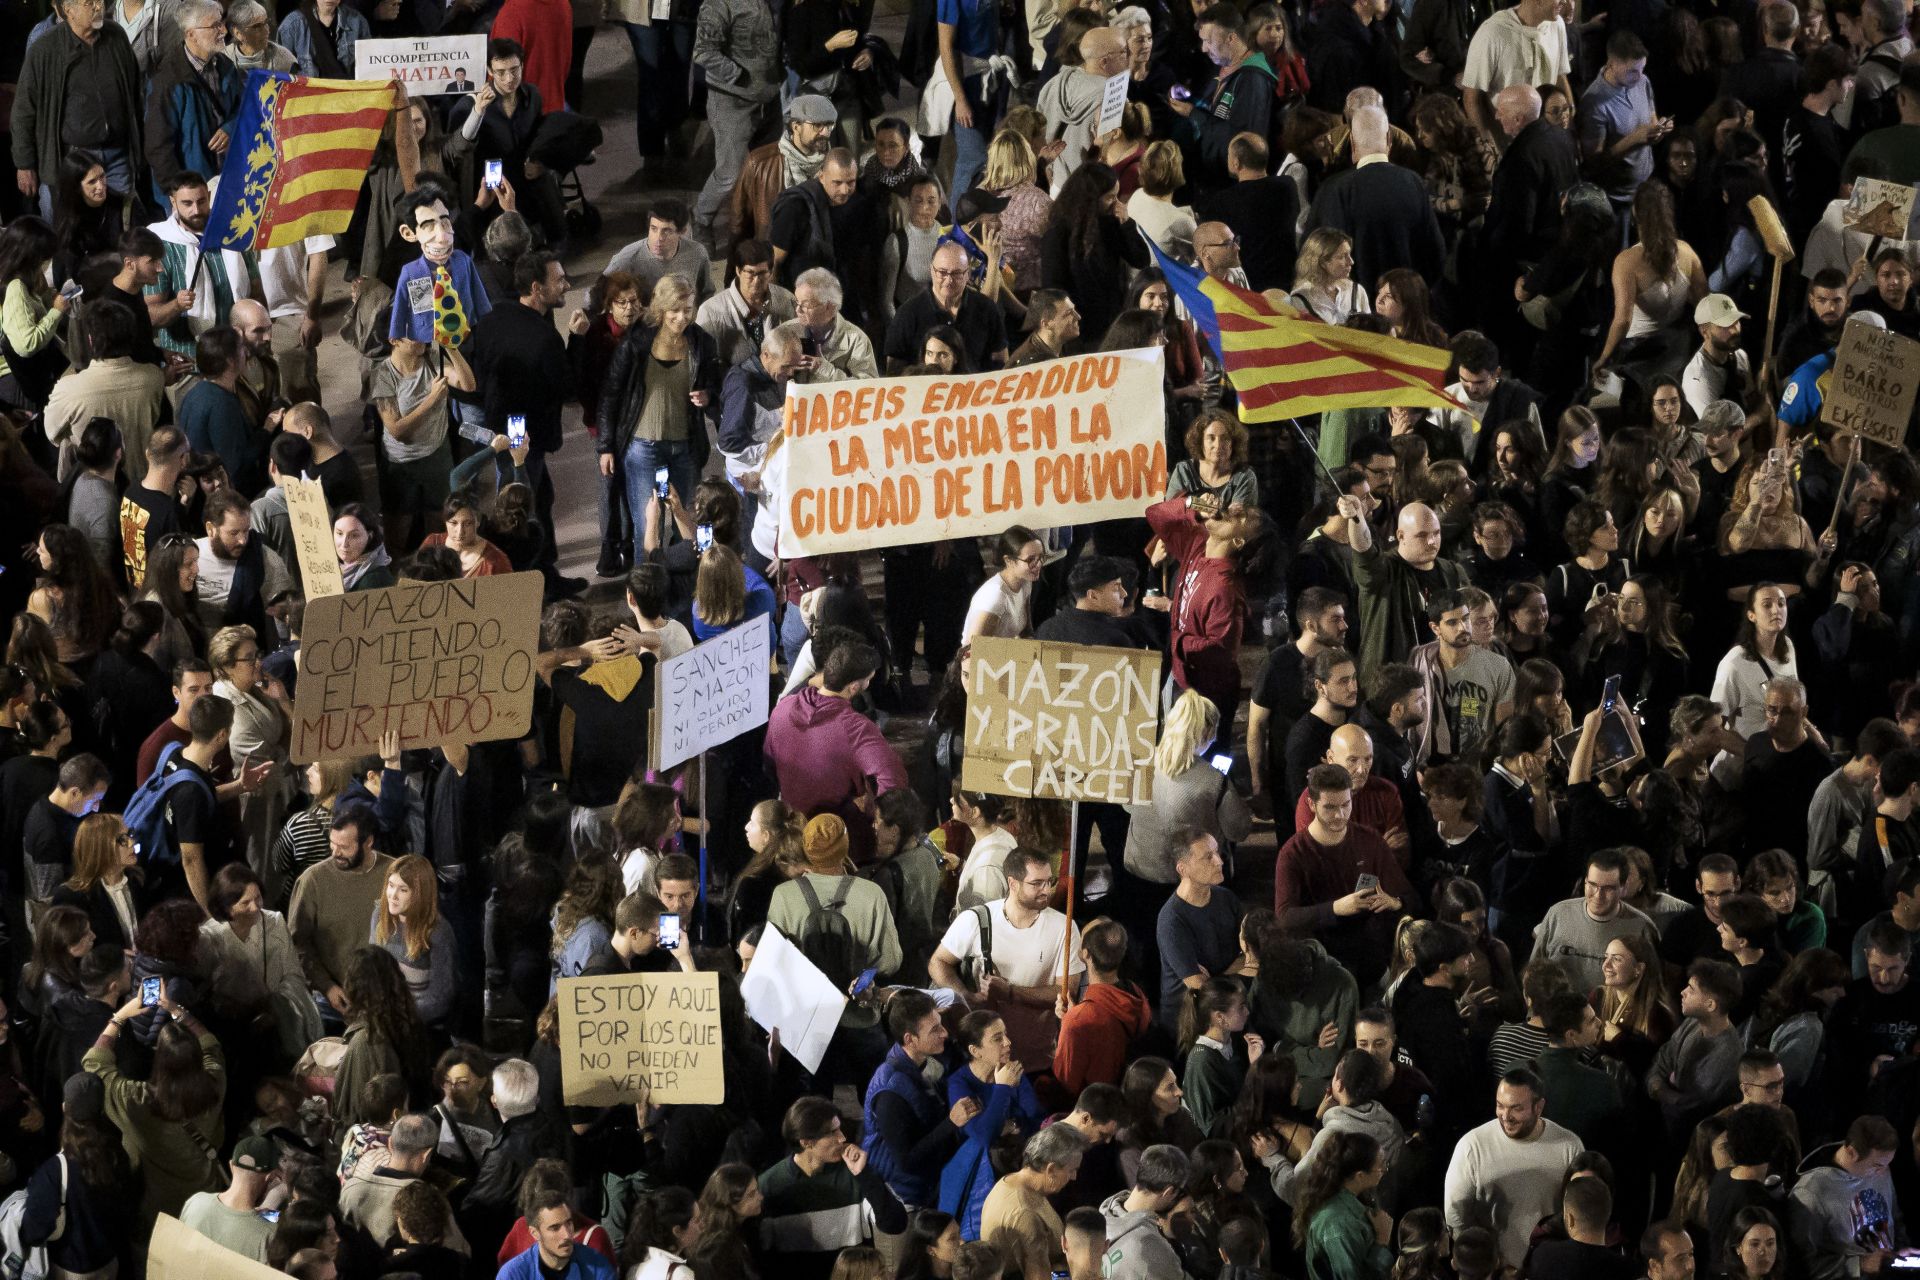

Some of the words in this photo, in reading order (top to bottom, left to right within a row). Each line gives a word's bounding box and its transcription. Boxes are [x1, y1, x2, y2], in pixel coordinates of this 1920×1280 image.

[369, 51, 471, 65] INCOMPETENCIA
[413, 42, 429, 51] TU
[390, 66, 452, 82] MATA
[1867, 333, 1895, 352] NOS
[1844, 363, 1902, 397] BARRO
[1867, 361, 1888, 377] EN
[784, 385, 907, 438] HABEIS
[921, 356, 1121, 414] ENCENDIDO
[1843, 380, 1898, 411] VOSOTROS
[828, 435, 869, 477] LA
[883, 412, 1001, 469] MECHA
[1006, 403, 1057, 453] EN
[1070, 402, 1112, 444] LA
[790, 474, 921, 540] CIUDAD
[934, 465, 974, 520] DE
[983, 459, 1024, 515] LA
[1034, 440, 1167, 507] POLVORA
[339, 580, 477, 634] MAZON
[305, 618, 507, 676] COMIENDO,
[322, 670, 371, 714] EL
[387, 648, 532, 707] PUEBLO
[975, 655, 1161, 718] MAZÓN
[673, 719, 689, 737] NI
[697, 687, 751, 722] OLVIDO
[674, 699, 685, 716] Y
[674, 737, 689, 753] NI
[971, 704, 992, 746] Y
[1006, 707, 1159, 771] PRADAS
[1003, 756, 1153, 806] CÁRCEL
[574, 984, 658, 1016] ESTOY
[669, 987, 717, 1012] AQUI
[578, 1020, 629, 1048] POR
[640, 1020, 675, 1045] LOS
[679, 1021, 718, 1046] QUE
[580, 1051, 611, 1070] NO
[627, 1050, 699, 1070] PUEDEN
[608, 1071, 679, 1092] VENIR
